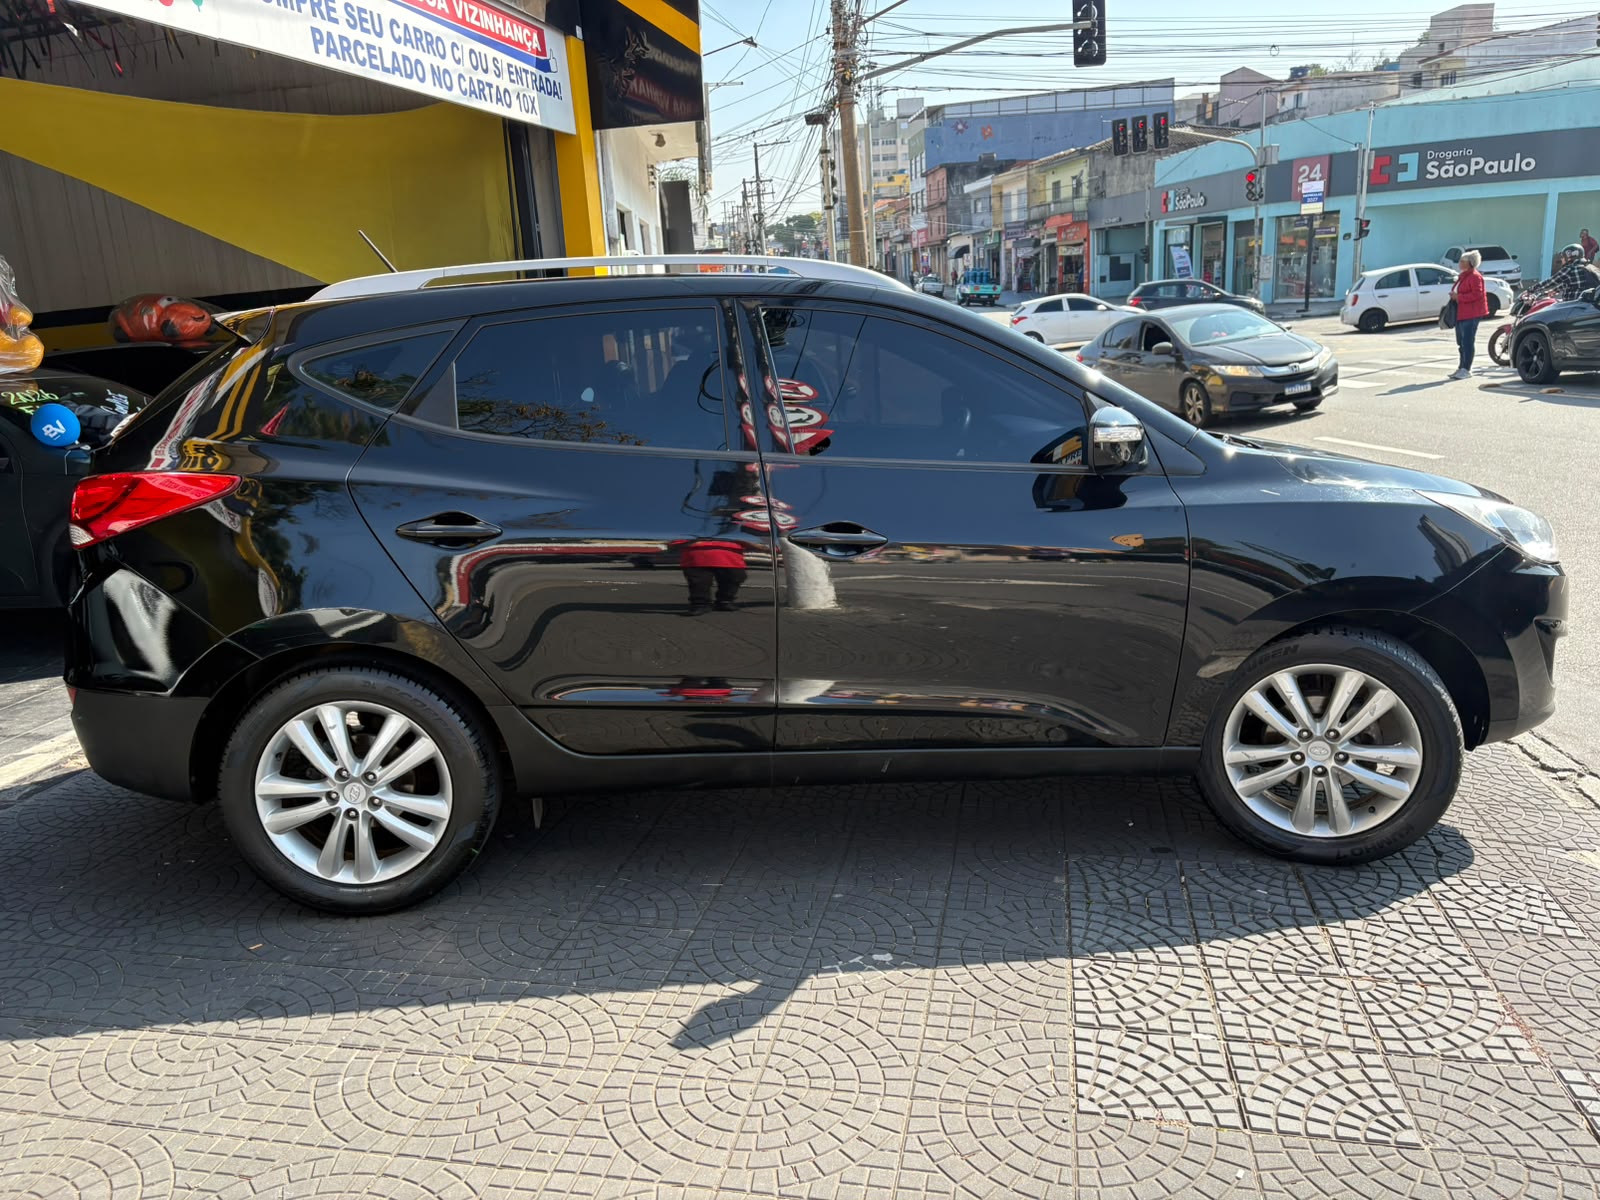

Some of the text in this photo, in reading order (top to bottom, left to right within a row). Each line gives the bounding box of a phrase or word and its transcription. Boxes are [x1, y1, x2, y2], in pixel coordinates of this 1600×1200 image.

[262, 0, 340, 25] PRE
[343, 2, 384, 38] SEU
[389, 18, 447, 60] CARRO
[468, 48, 489, 75] OU
[506, 62, 563, 101] ENTRADA!
[452, 0, 542, 52] VIZINHANÇA
[310, 26, 538, 116] PARCELADO NO CARTAO 10X
[1298, 163, 1322, 184] 24
[1427, 148, 1473, 160] Drogaria
